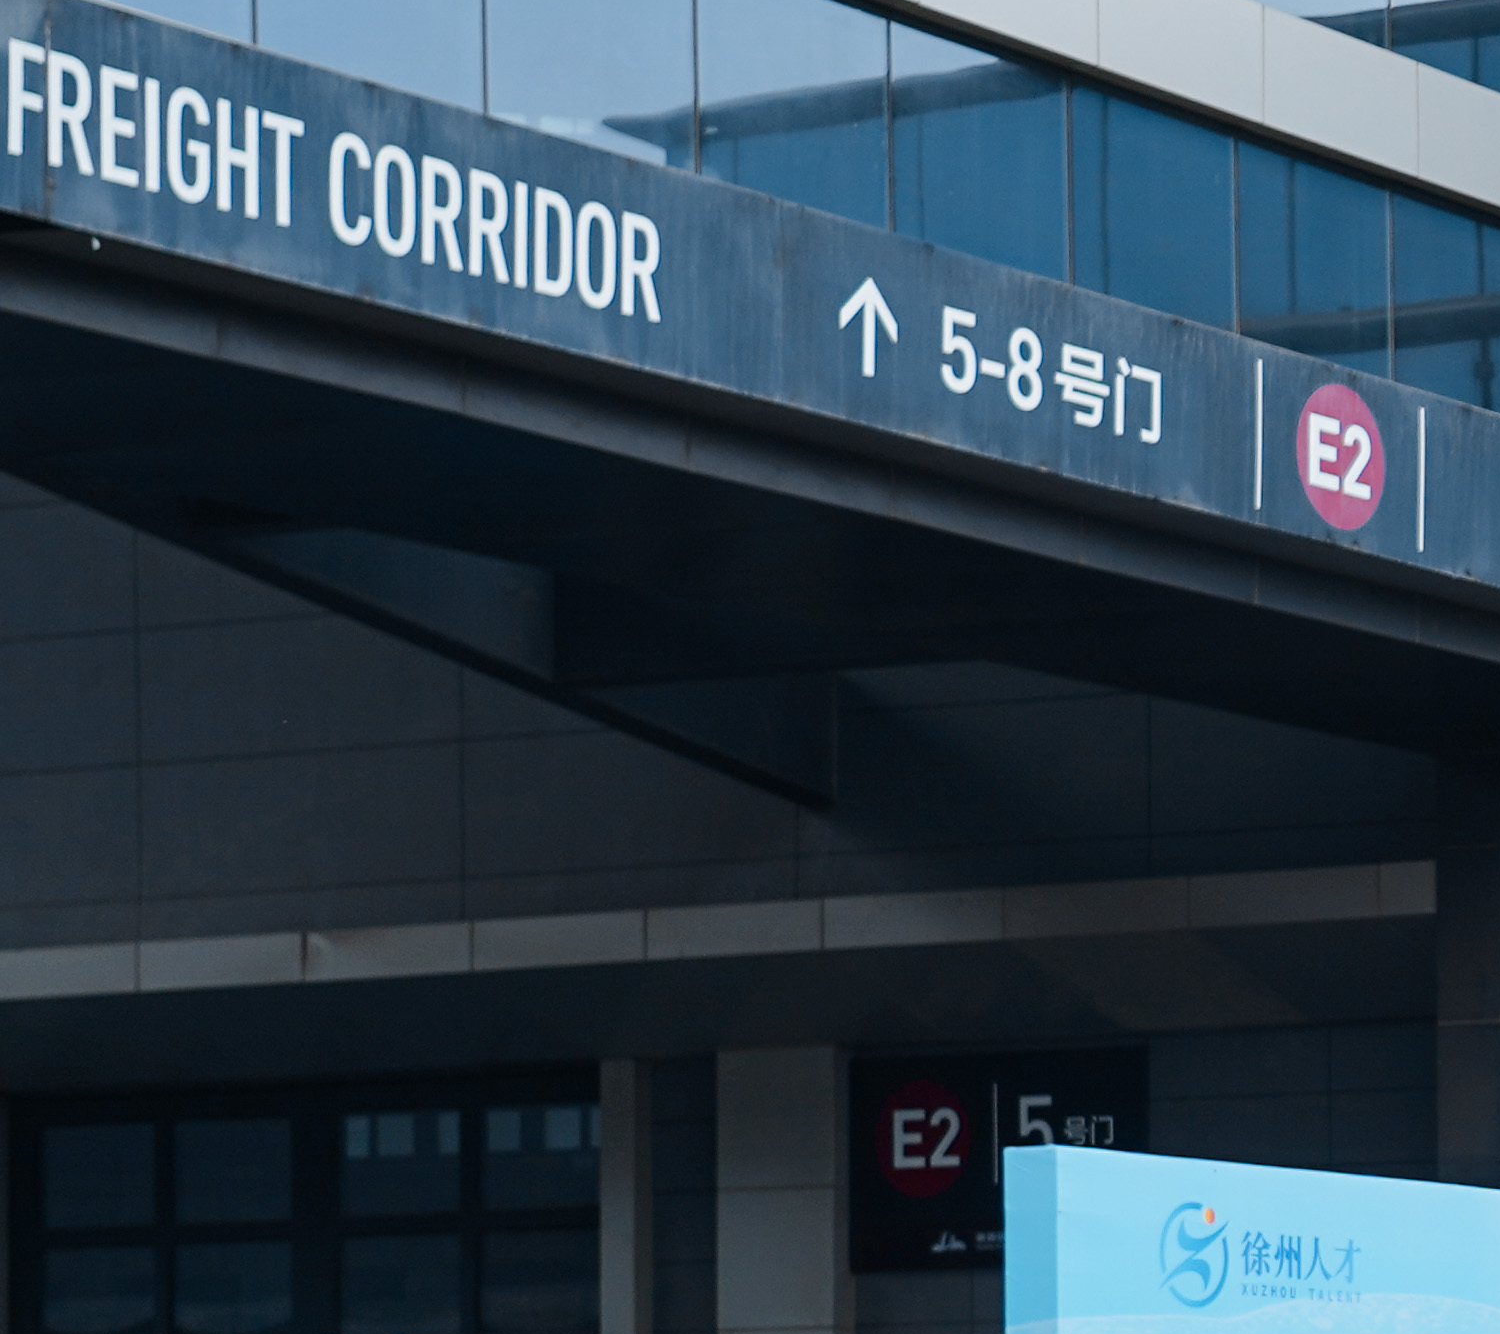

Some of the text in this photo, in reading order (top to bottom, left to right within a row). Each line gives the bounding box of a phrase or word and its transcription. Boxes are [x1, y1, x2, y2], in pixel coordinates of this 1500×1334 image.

[6, 37, 663, 324] FREIGHT CORRIDOR
[939, 304, 1163, 446] 5-8号门
[1307, 411, 1373, 502] E2
[891, 1106, 961, 1170] E2
[1240, 1229, 1361, 1284] 徐州人才
[1240, 1283, 1362, 1304] XUZHOU TALENT
